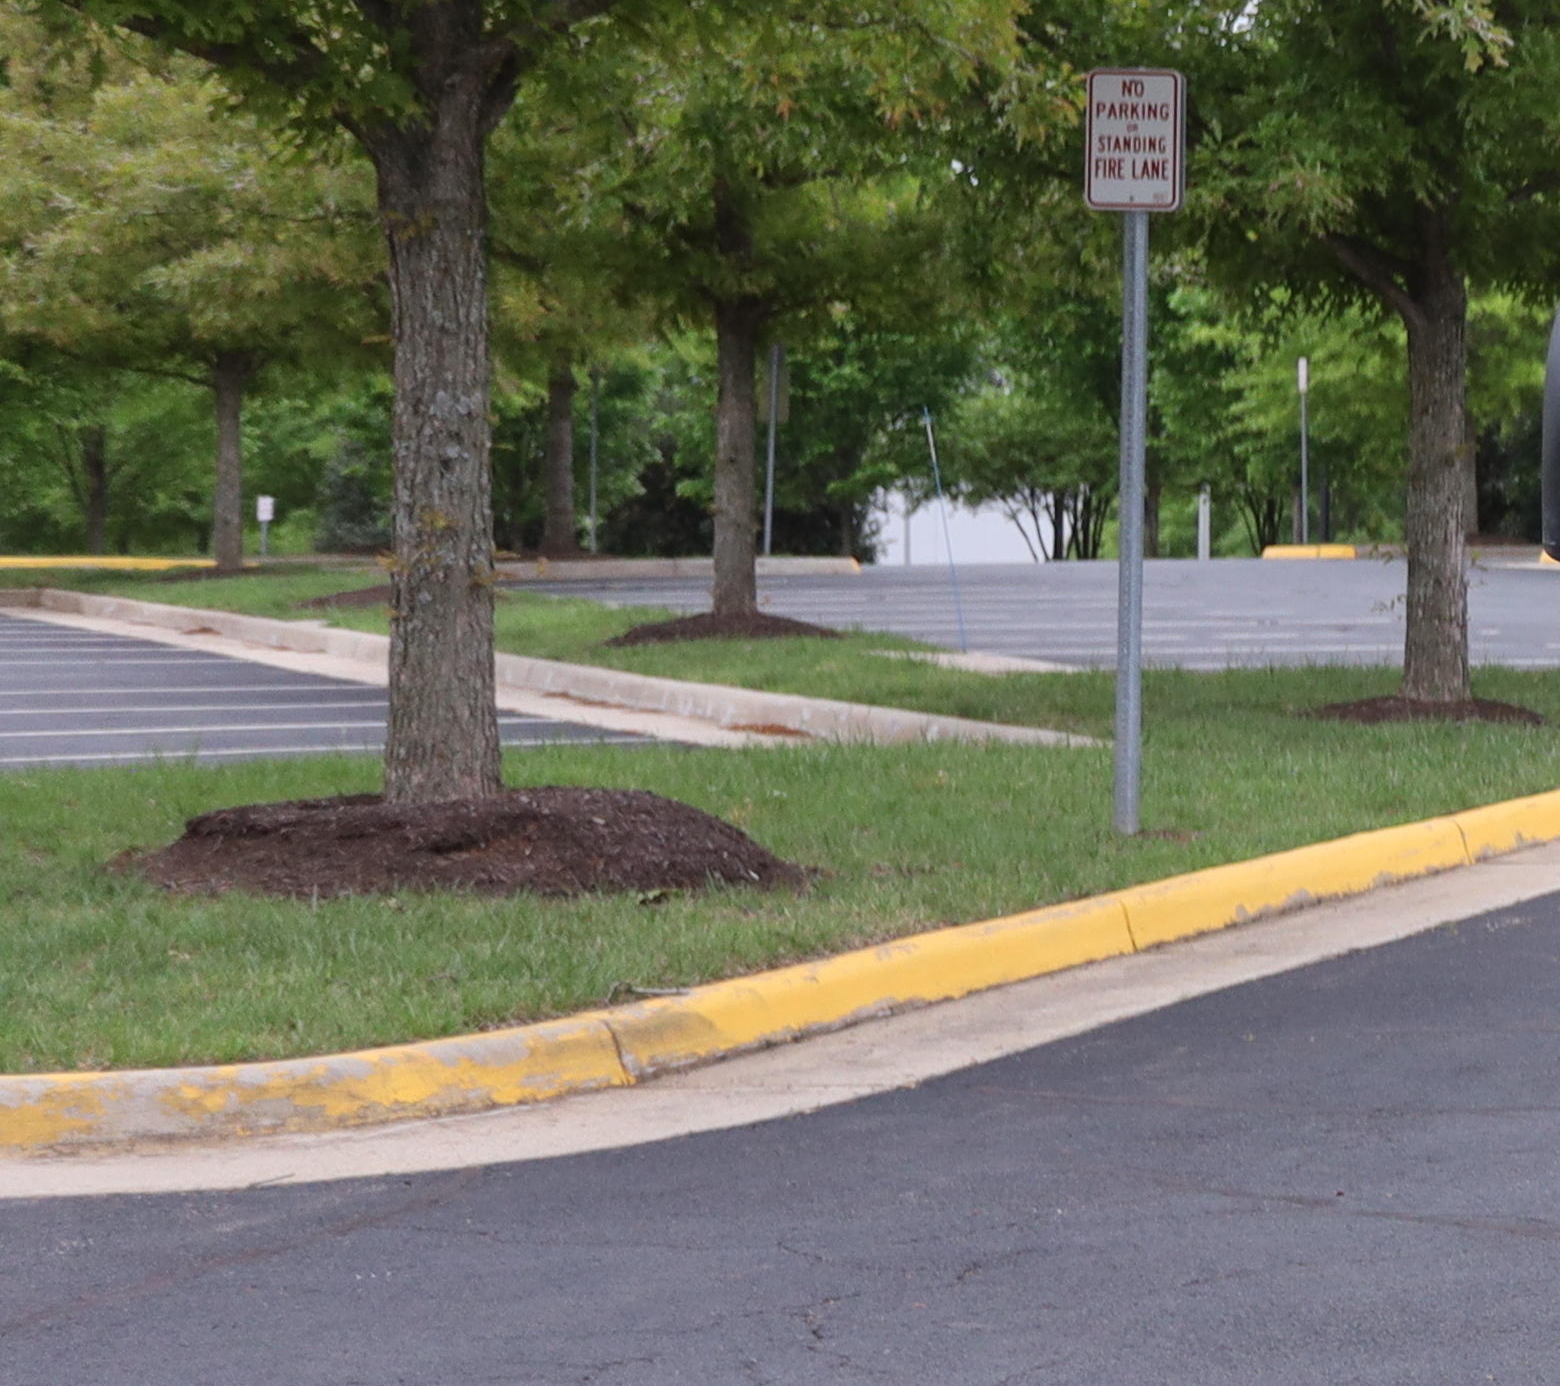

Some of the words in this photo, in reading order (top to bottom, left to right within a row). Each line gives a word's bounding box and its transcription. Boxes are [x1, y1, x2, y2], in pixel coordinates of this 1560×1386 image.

[1121, 79, 1145, 98] NO
[1095, 100, 1170, 121] PARKING
[1097, 134, 1167, 154] STANDING
[1094, 157, 1126, 181] FIRE
[1131, 157, 1169, 181] LANE
